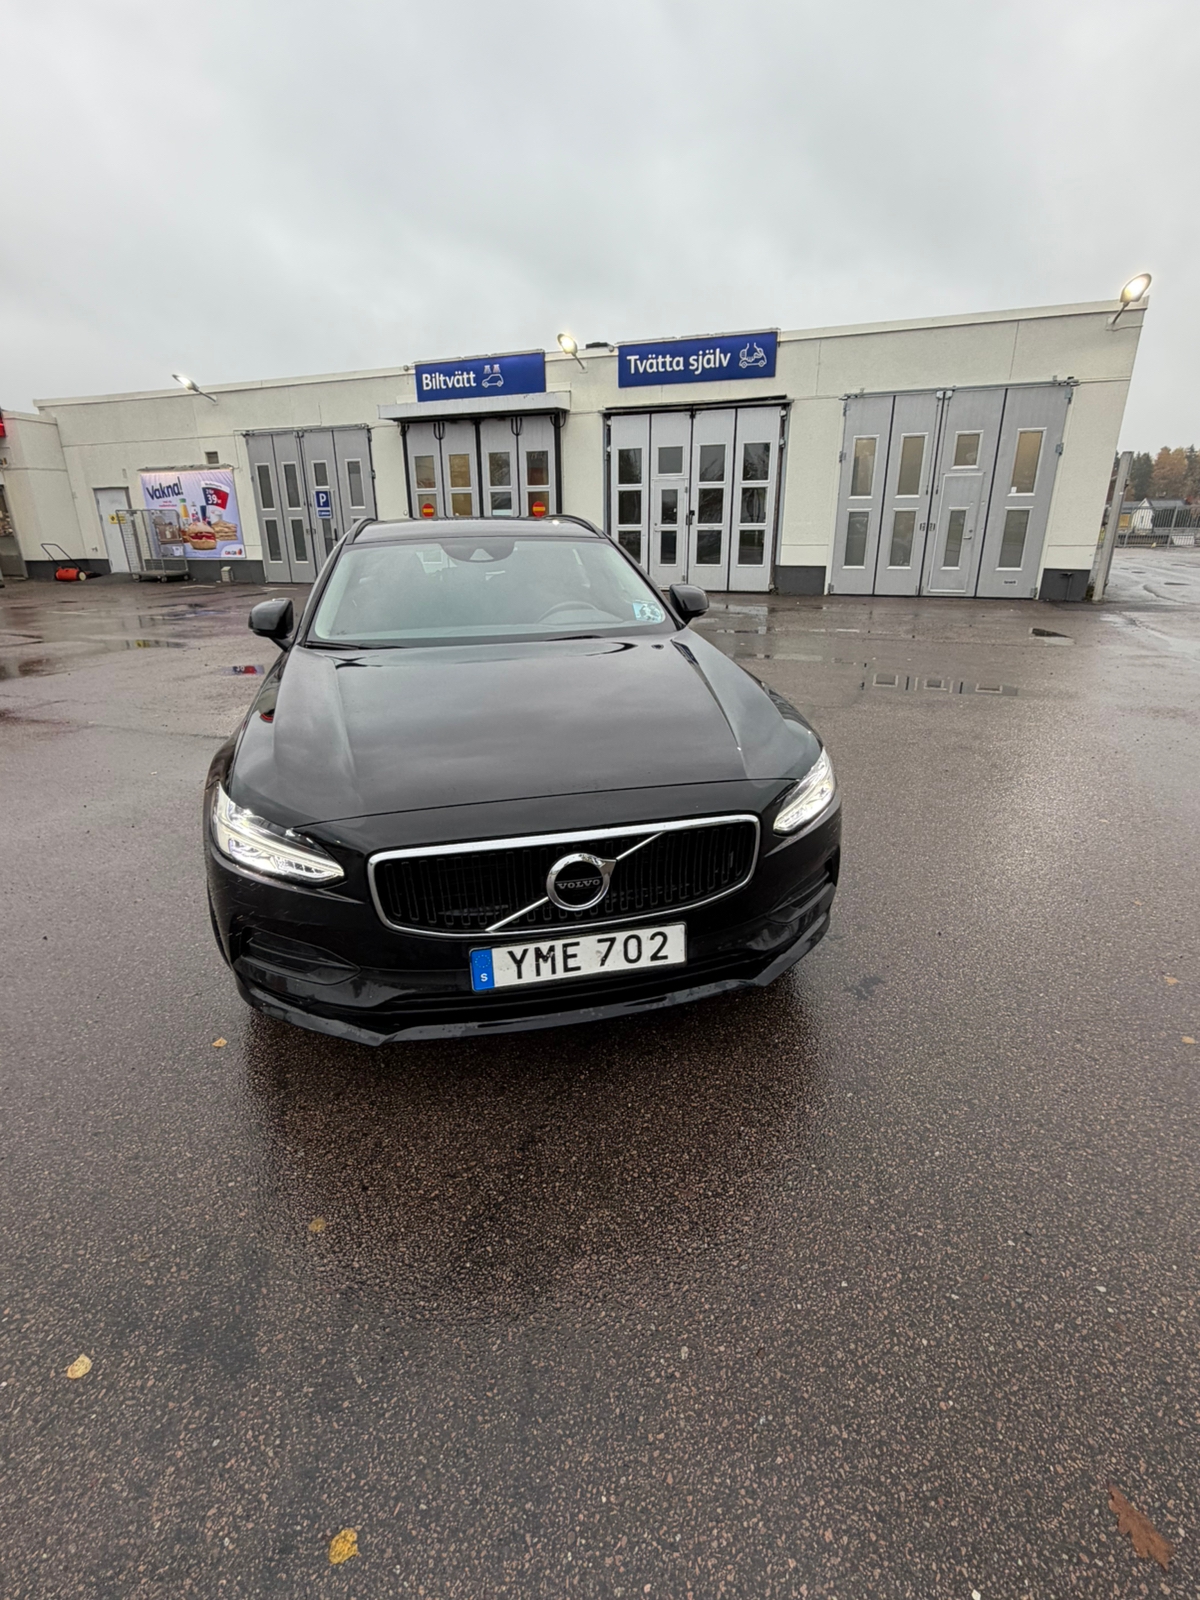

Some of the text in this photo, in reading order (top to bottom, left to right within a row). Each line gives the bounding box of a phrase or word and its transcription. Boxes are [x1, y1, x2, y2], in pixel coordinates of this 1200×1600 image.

[626, 348, 731, 375] Tvätta själv
[422, 371, 477, 390] Biltvätt
[146, 476, 184, 500] Vakna!
[206, 494, 217, 504] 39
[319, 493, 327, 506] P
[557, 879, 600, 889] VOLVO
[507, 931, 669, 979] YME 702
[480, 973, 488, 982] S
